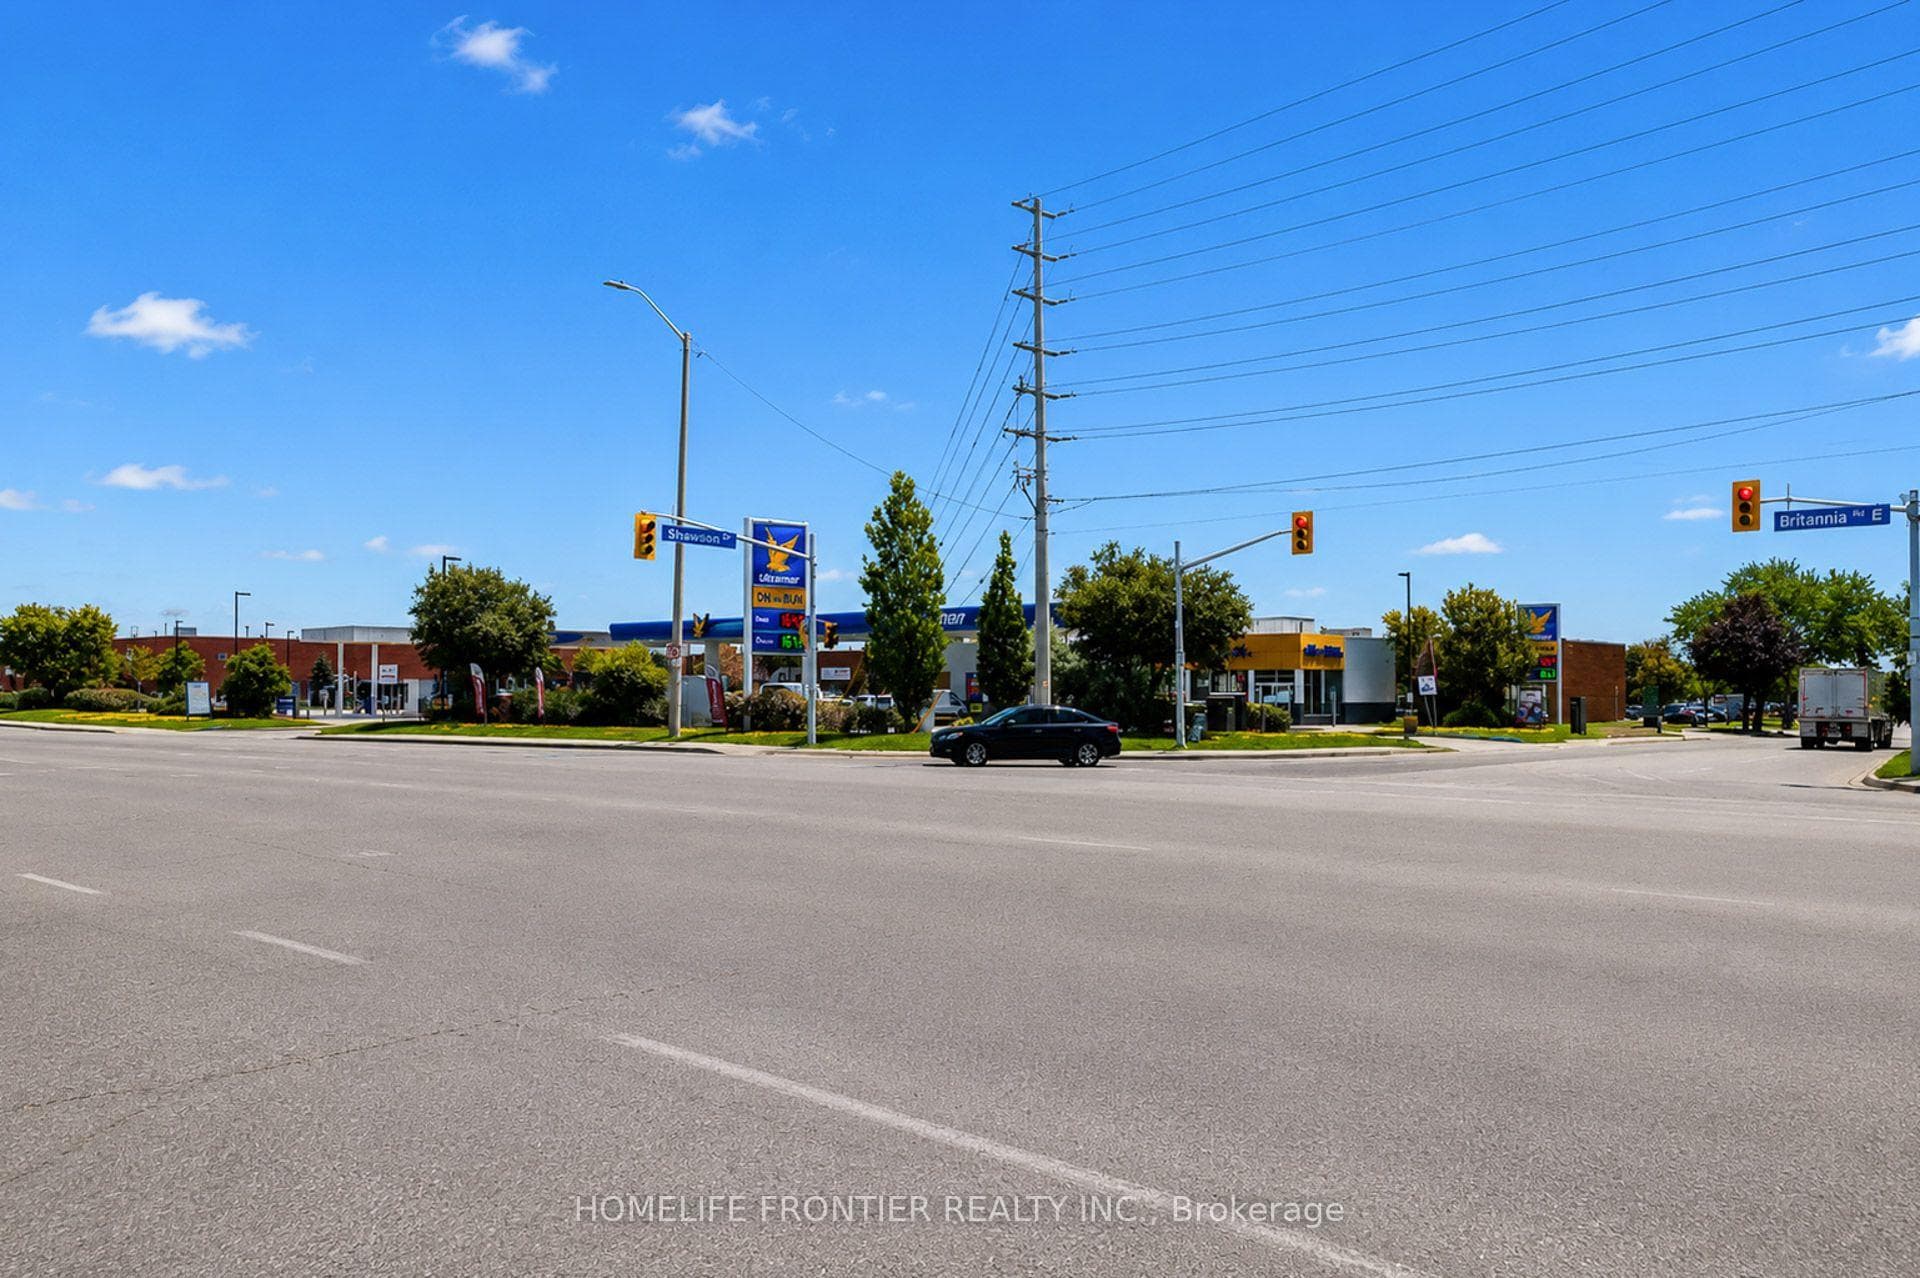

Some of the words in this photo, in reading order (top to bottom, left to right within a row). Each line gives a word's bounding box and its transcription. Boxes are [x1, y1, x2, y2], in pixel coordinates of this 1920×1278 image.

[1780, 511, 1847, 528] Britannia
[1872, 508, 1883, 521] E
[668, 528, 720, 543] Shawson
